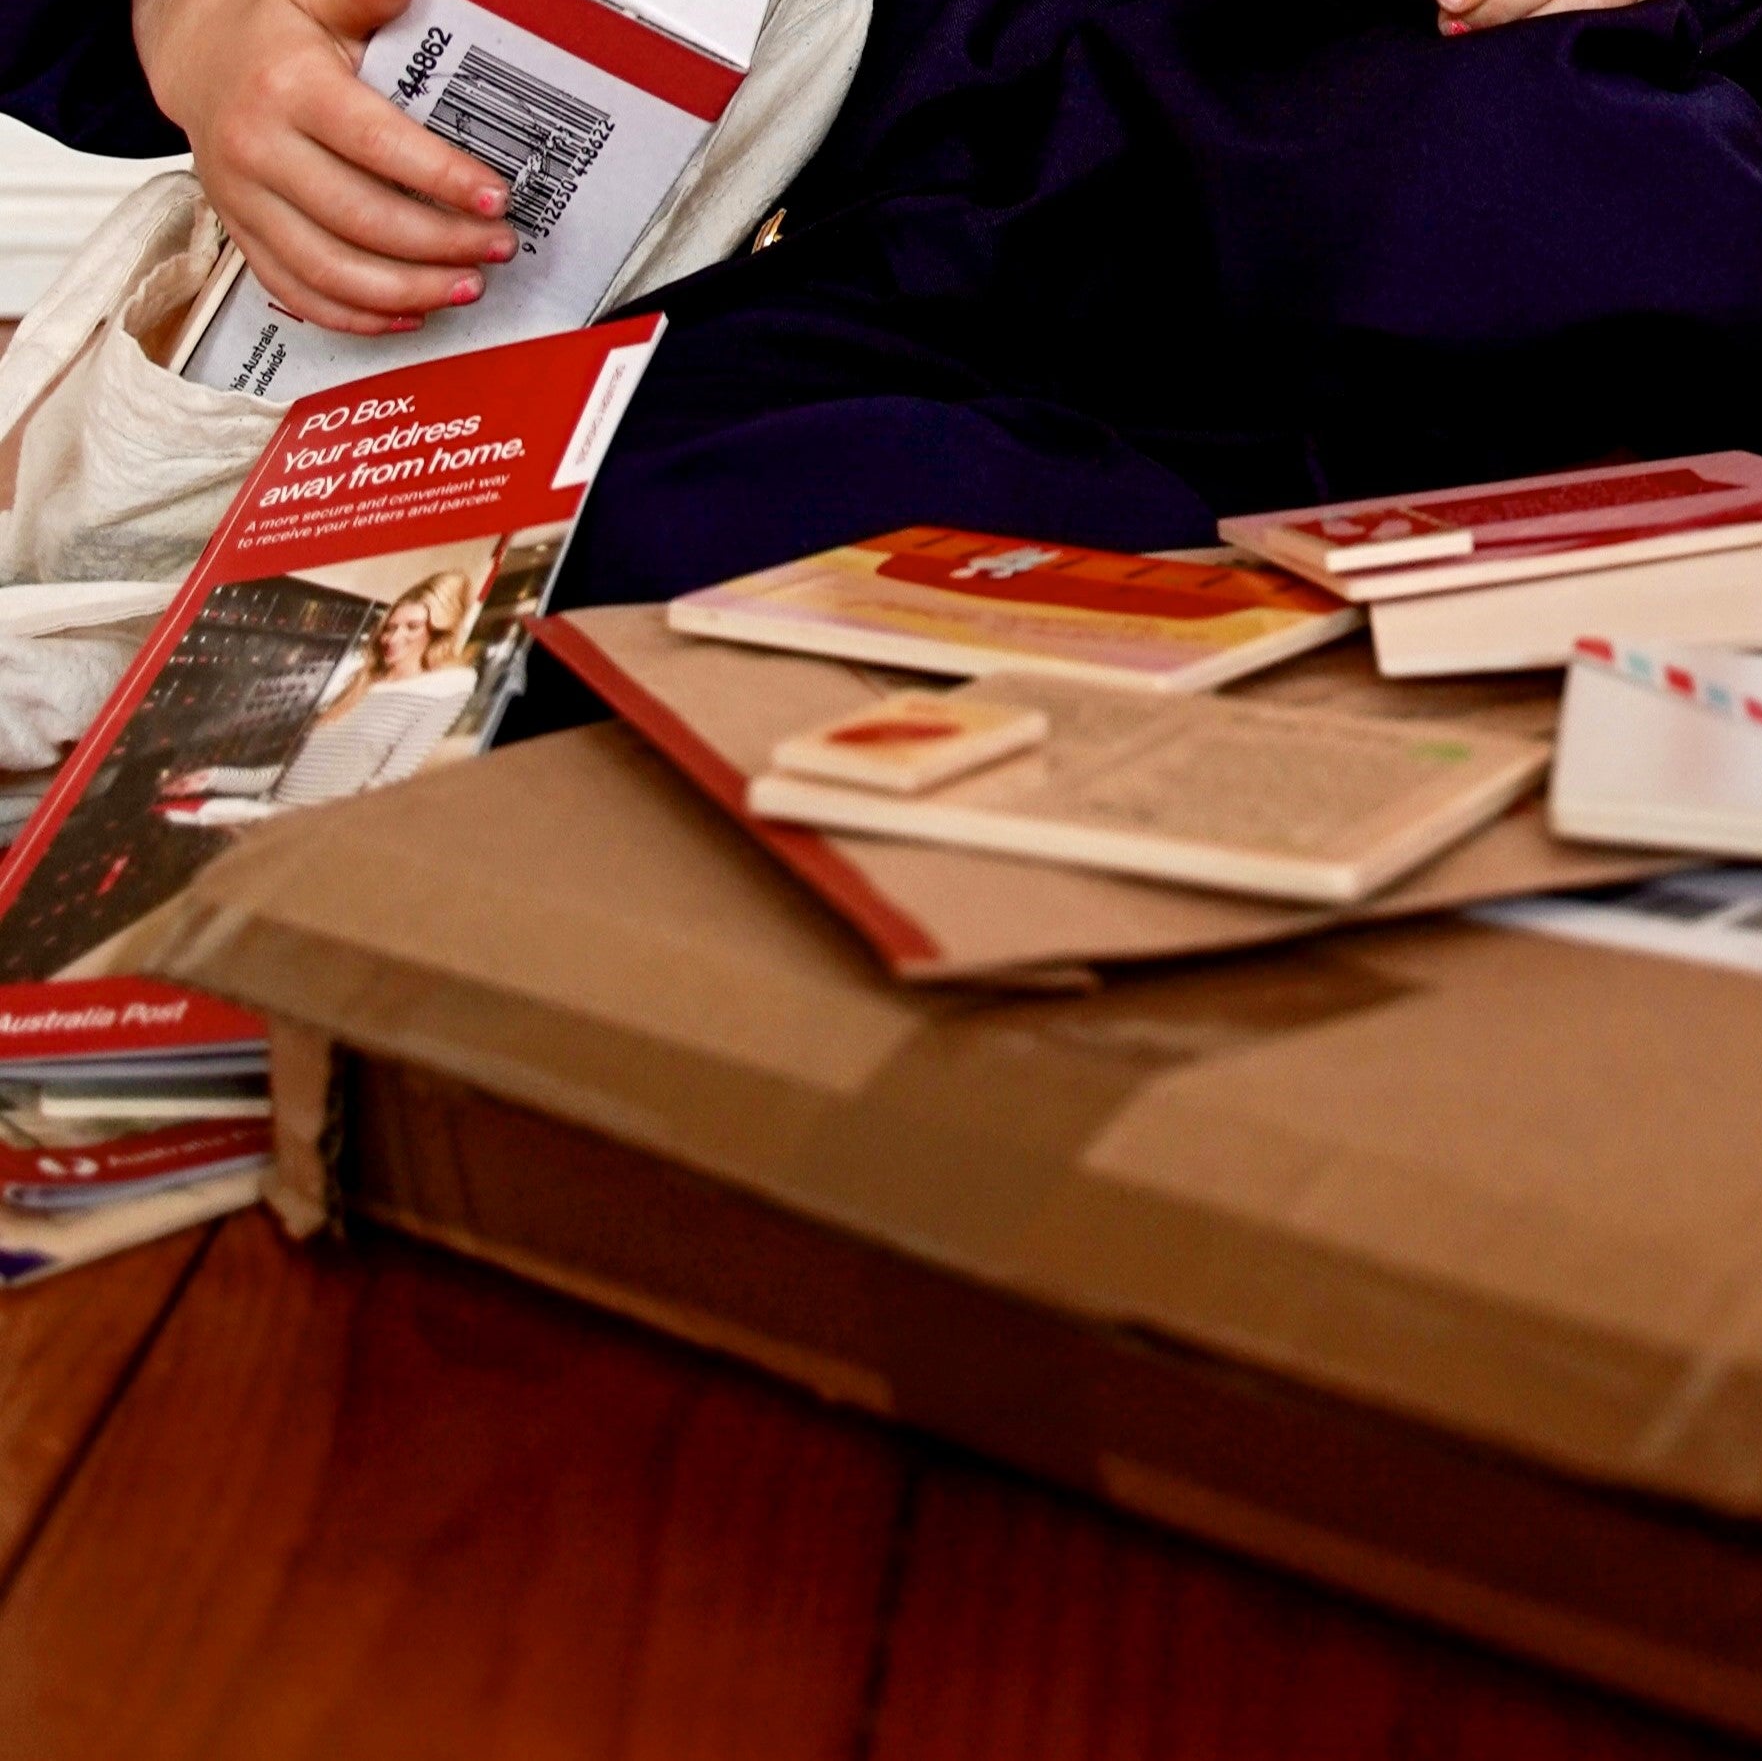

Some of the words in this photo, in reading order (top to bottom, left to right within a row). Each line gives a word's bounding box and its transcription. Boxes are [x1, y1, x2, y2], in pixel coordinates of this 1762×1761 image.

[396, 25, 454, 100] 44862
[521, 241, 538, 256] 9
[533, 175, 580, 239] 312650
[570, 118, 617, 178] 448622
[242, 323, 280, 375] Australia
[253, 343, 287, 397] orldwide^
[283, 441, 353, 475] Your
[351, 414, 482, 459] address
[297, 406, 351, 441] PO
[350, 393, 417, 426] Box.
[244, 521, 257, 535] A
[259, 514, 300, 531] more
[301, 503, 354, 523] secure
[356, 493, 387, 512] and
[388, 476, 476, 505] convenient
[478, 472, 511, 490] way
[258, 472, 347, 509] away
[347, 456, 426, 490] from
[428, 437, 527, 476] home.
[236, 538, 254, 551] to
[256, 525, 312, 547] receive
[313, 519, 348, 538] your
[351, 508, 405, 528] letters
[407, 502, 438, 519] and
[438, 490, 502, 515] parcels.
[120, 998, 189, 1026] Post
